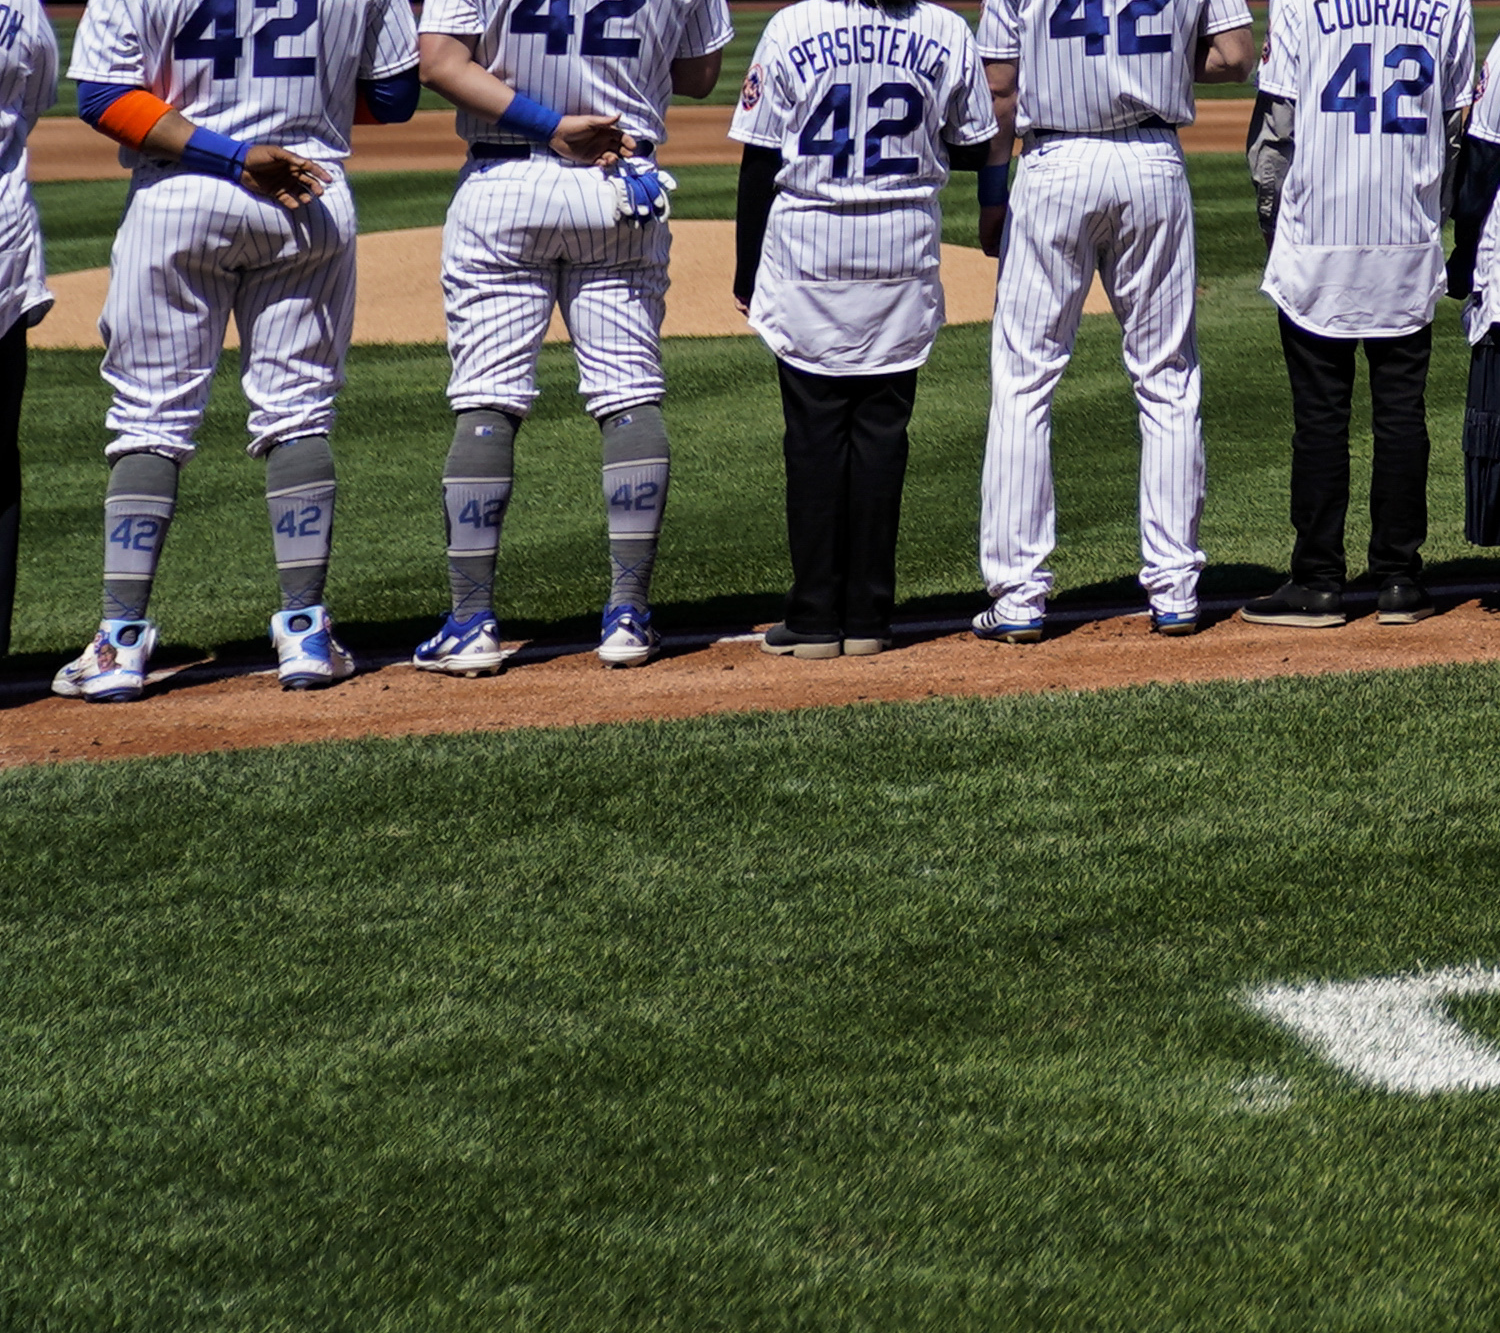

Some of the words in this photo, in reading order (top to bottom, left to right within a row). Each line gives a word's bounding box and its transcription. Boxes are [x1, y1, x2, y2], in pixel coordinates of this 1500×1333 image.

[788, 24, 950, 85] PERSISTENCE
[1321, 44, 1434, 135] 42
[799, 83, 924, 178] 42
[457, 498, 503, 529] 42
[609, 482, 657, 513] 42
[109, 517, 159, 552] 42
[276, 505, 322, 539] 42
